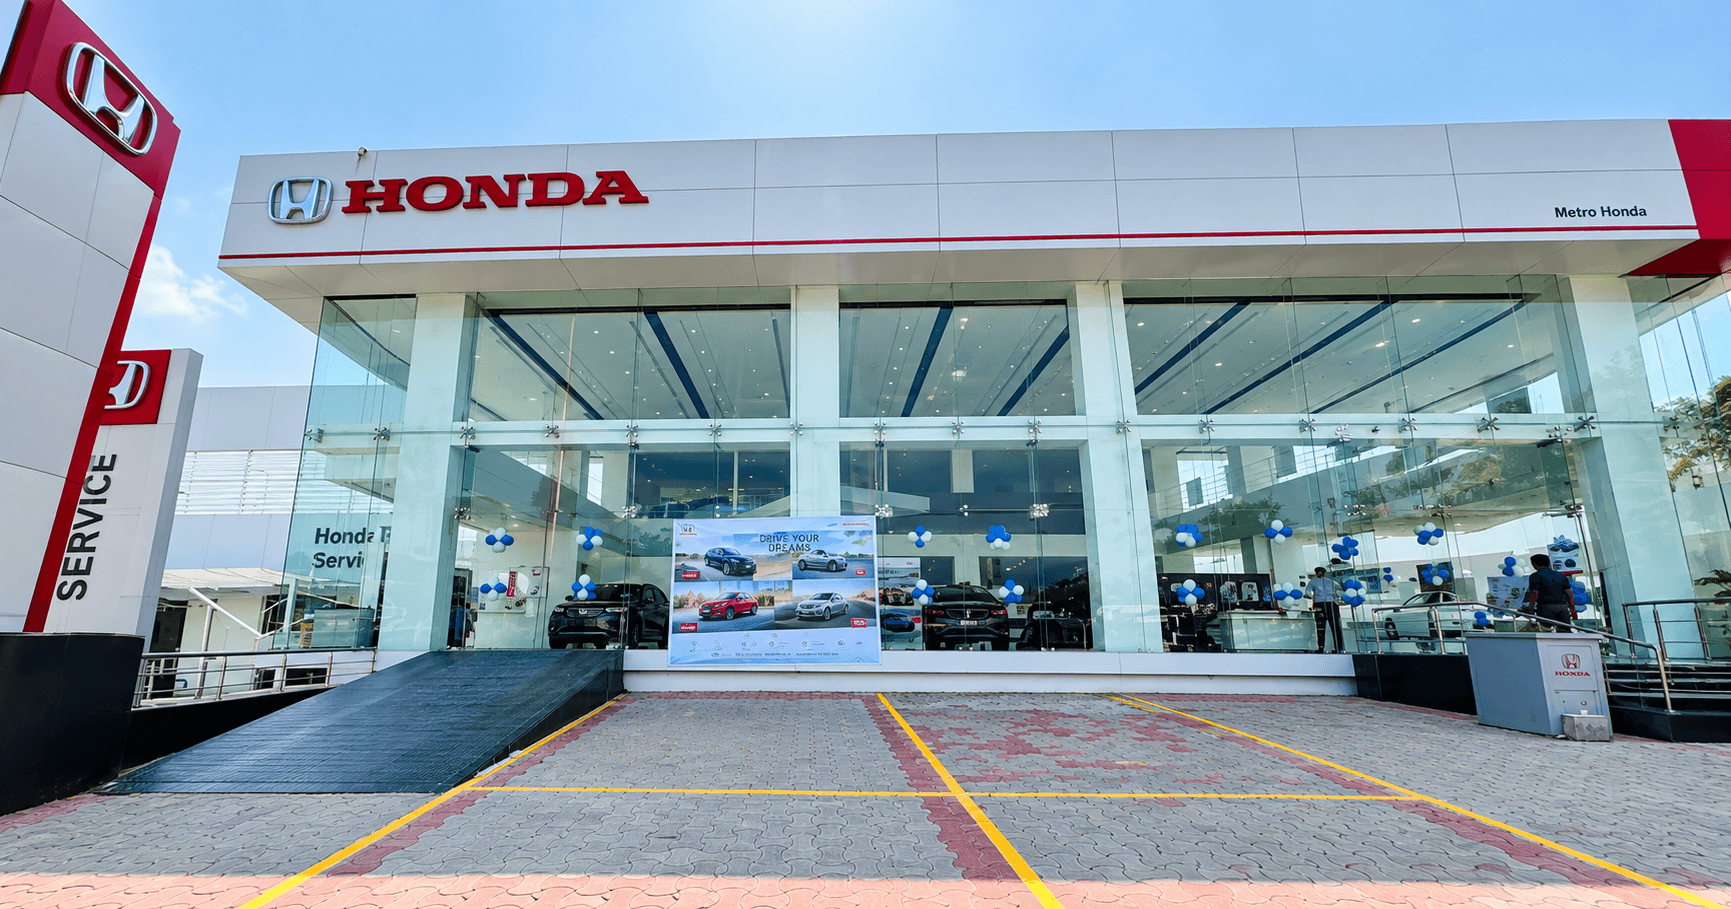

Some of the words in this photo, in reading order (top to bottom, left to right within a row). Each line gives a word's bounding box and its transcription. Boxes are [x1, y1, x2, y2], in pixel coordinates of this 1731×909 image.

[342, 170, 649, 214] HONDA
[1554, 206, 1597, 218] Metro
[1600, 205, 1647, 217] Honda
[56, 454, 117, 601] SERVICE
[792, 533, 819, 543] YOUR
[312, 551, 365, 568] Servi
